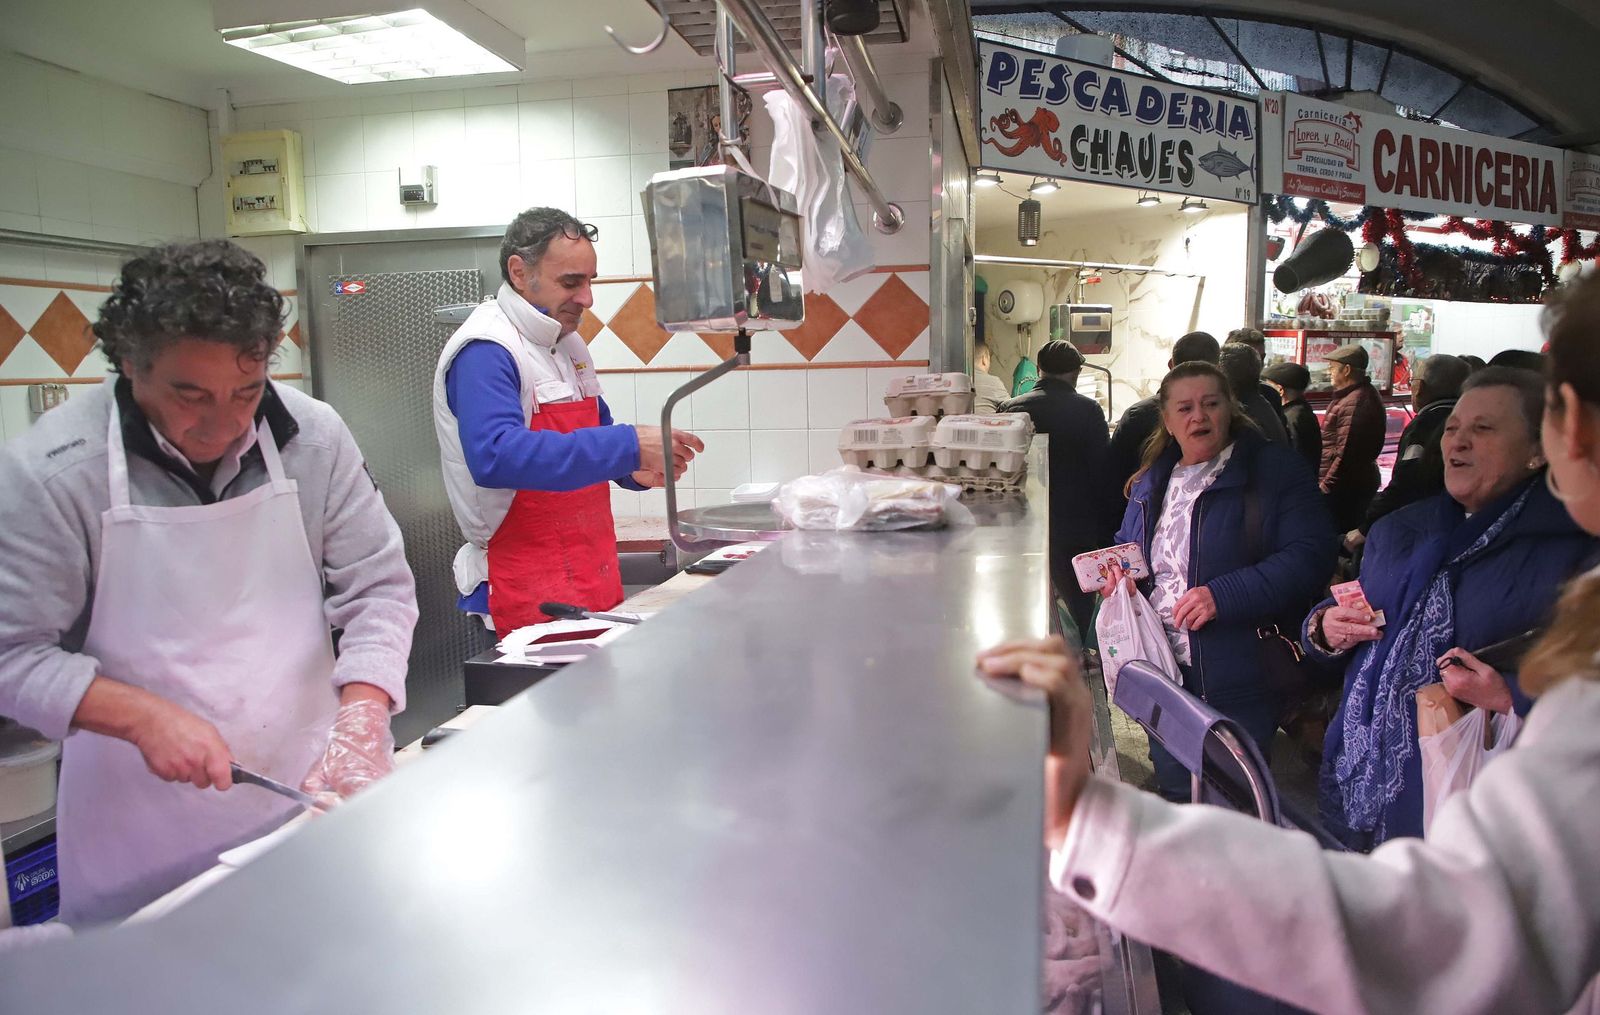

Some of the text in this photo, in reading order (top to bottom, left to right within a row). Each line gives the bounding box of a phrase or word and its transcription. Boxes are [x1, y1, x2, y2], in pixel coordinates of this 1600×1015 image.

[986, 51, 1253, 140] PESCADERIA
[1297, 128, 1320, 142] Loren
[1323, 133, 1330, 147] y
[1320, 168, 1334, 178] CERDO
[1373, 128, 1558, 215] CARNICERIA
